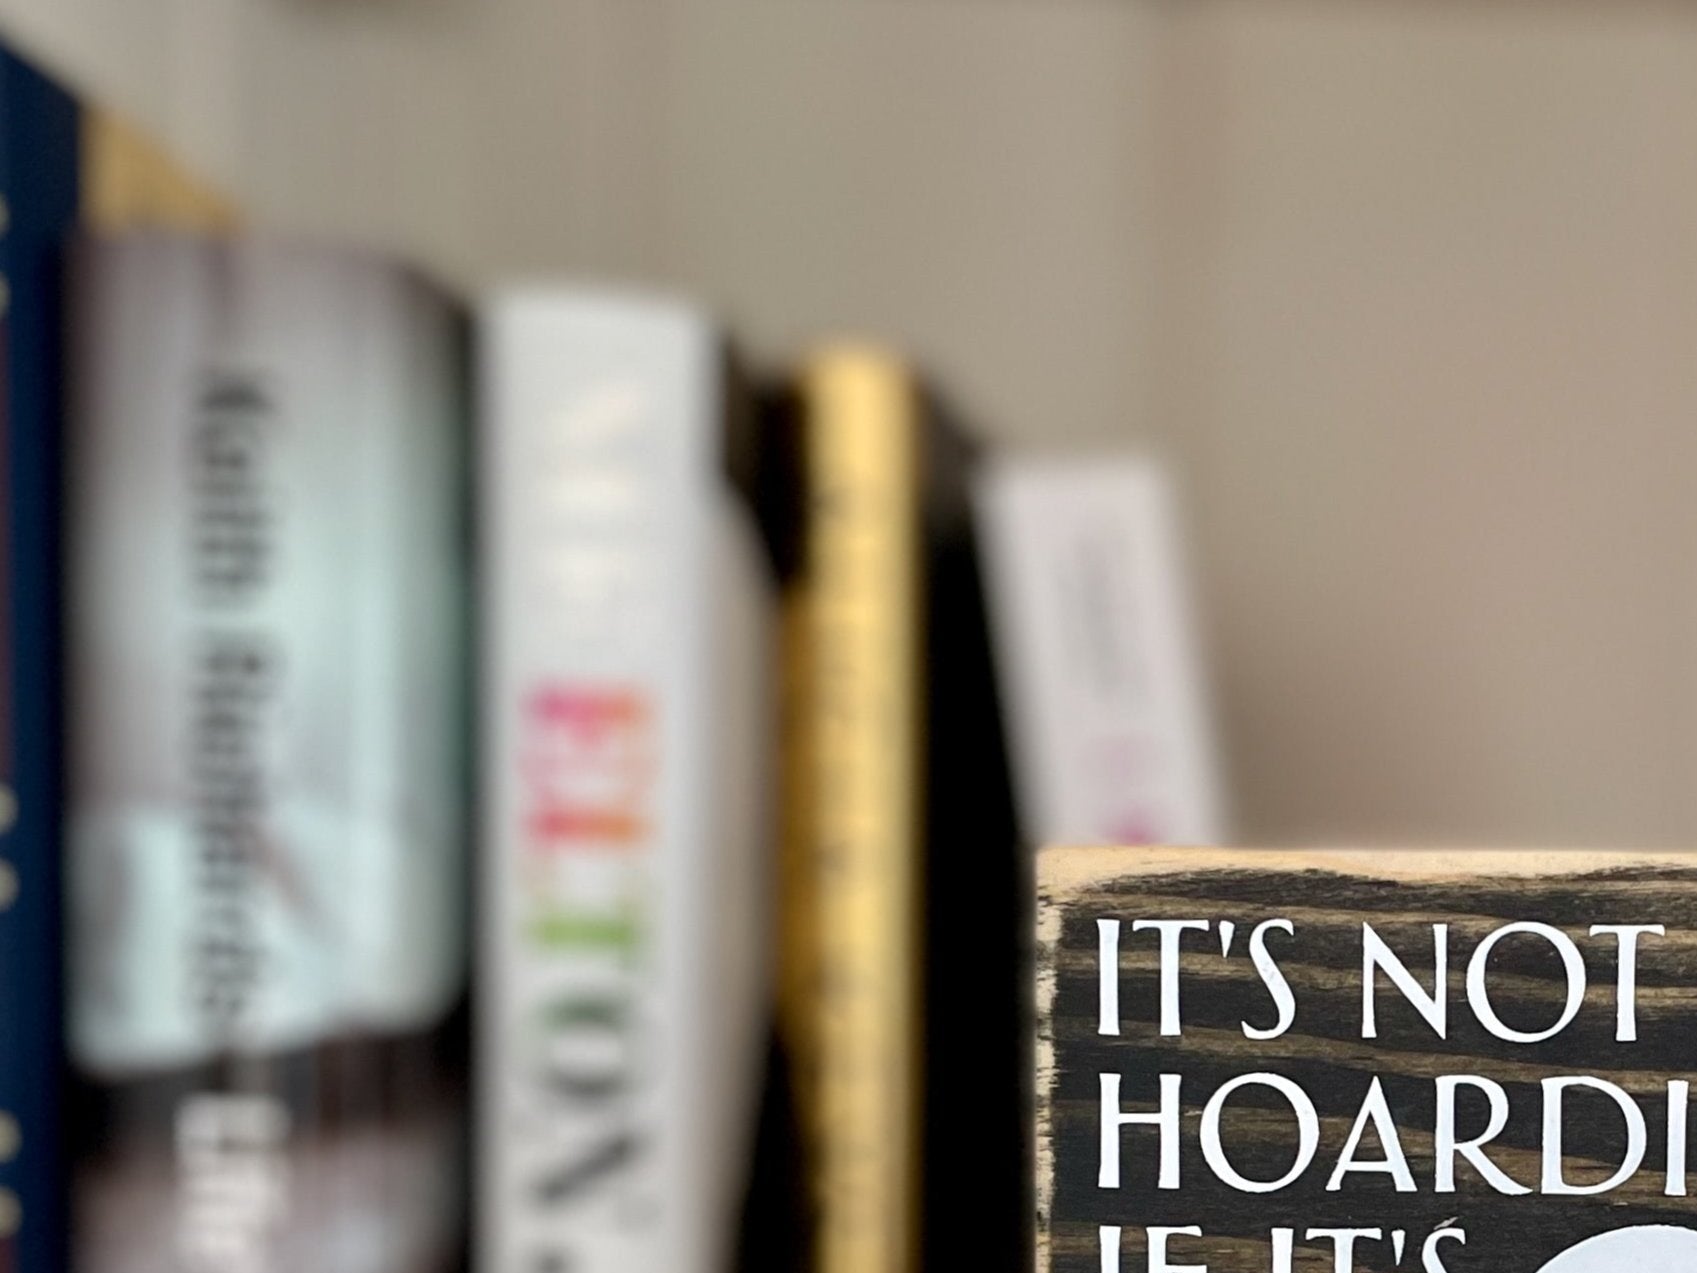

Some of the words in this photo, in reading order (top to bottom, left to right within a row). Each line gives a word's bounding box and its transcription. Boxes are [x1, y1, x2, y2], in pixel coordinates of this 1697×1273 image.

[522, 680, 656, 1236] ELTON
[1096, 918, 1297, 1041] IT'S
[1361, 920, 1667, 1044] NOT
